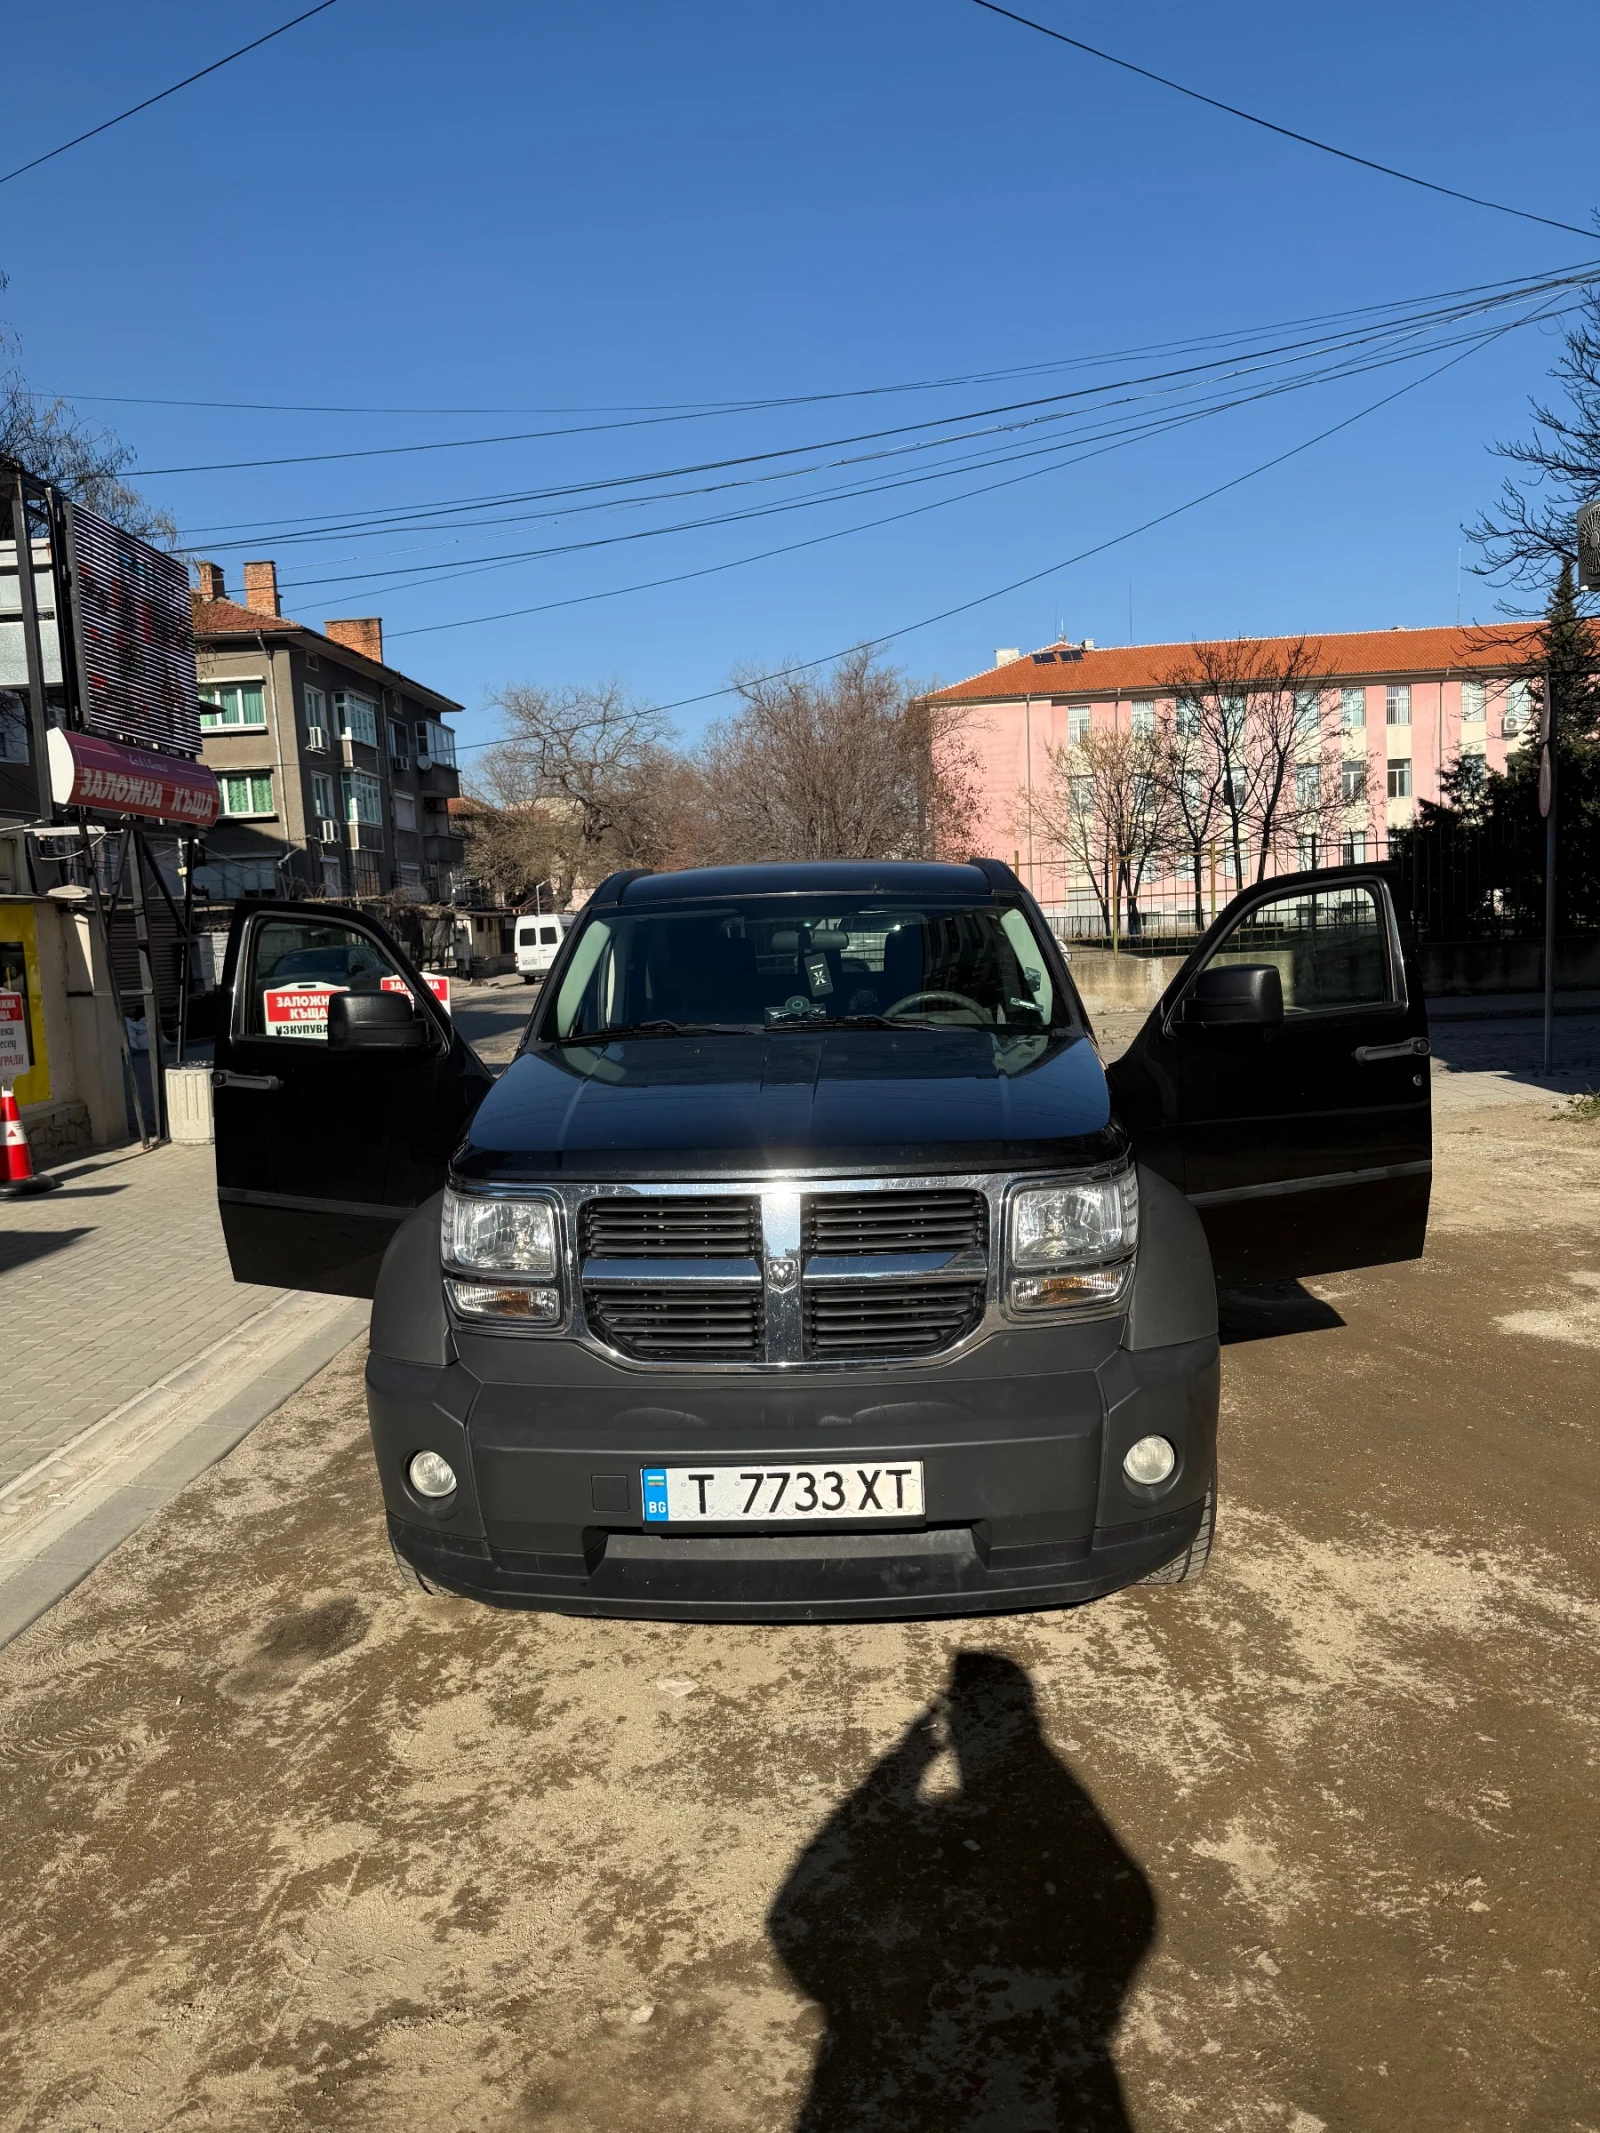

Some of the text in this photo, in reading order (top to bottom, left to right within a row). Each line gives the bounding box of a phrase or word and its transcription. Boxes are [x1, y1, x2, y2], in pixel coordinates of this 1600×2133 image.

[80, 768, 213, 819] ЗАЛОЖНА КЪЩА
[389, 981, 440, 991] ЗАЛНА
[276, 995, 330, 1008] ЗАЛОЖН
[290, 1007, 329, 1020] КЪЩА
[0, 1027, 14, 1036] еки
[275, 1024, 328, 1036] ИЗКУПУВА
[0, 1040, 16, 1051] есец
[0, 1053, 24, 1067] ГРАДИ
[688, 1469, 912, 1514] T 7733 XT
[648, 1501, 667, 1514] BG
